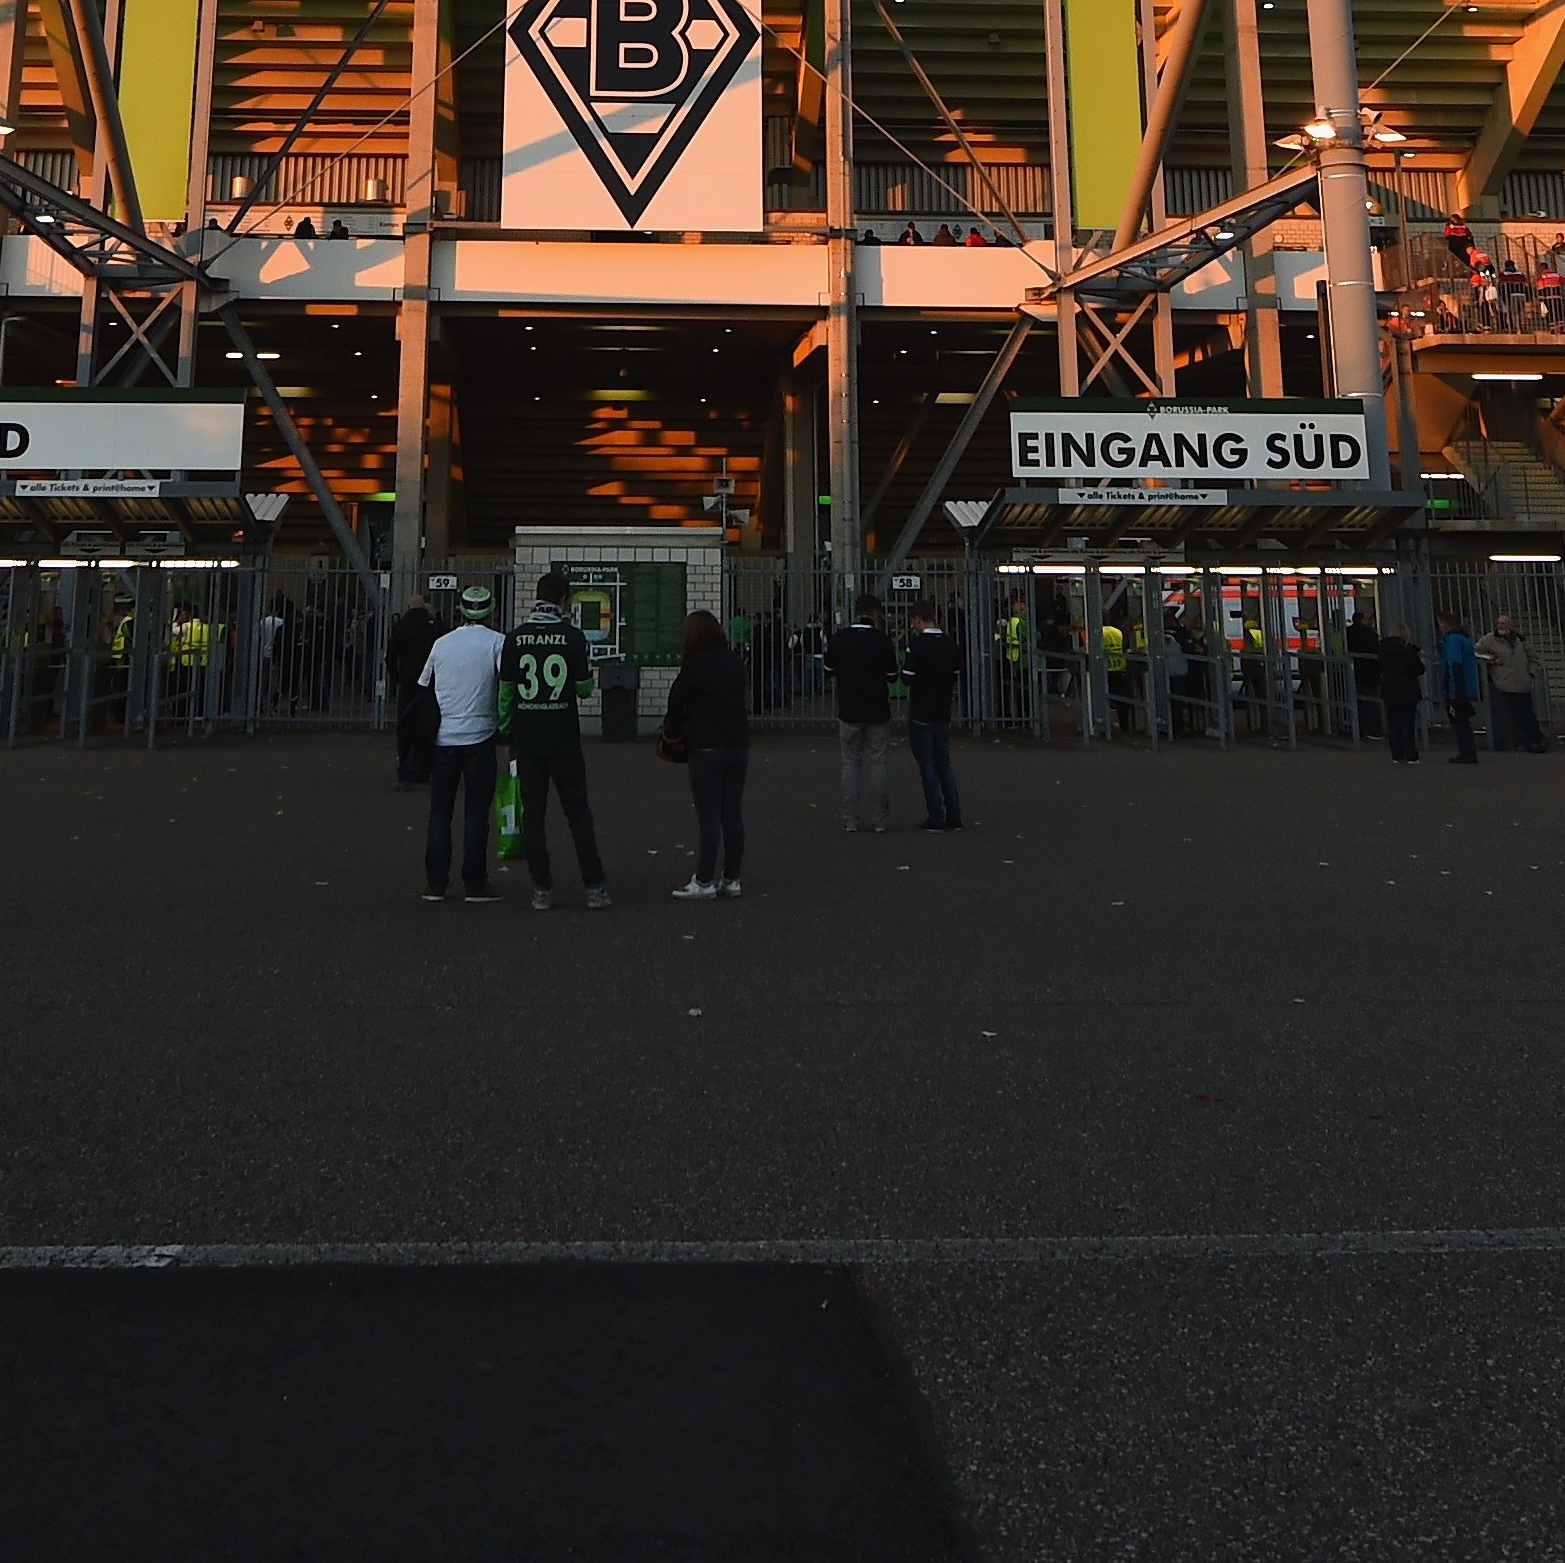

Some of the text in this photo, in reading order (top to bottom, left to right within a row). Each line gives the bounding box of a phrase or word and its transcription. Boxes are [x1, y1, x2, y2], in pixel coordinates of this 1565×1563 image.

[1159, 405, 1230, 414] BORUSSIA-PARK
[1017, 422, 1362, 470] EINGANG SÜD
[29, 483, 146, 494] alle Tickets & print@home
[1087, 490, 1200, 502] alle Tickets & print@home
[435, 578, 450, 588] 59
[899, 578, 913, 588] 58
[515, 633, 568, 647] STRANZL
[517, 652, 569, 701] 39
